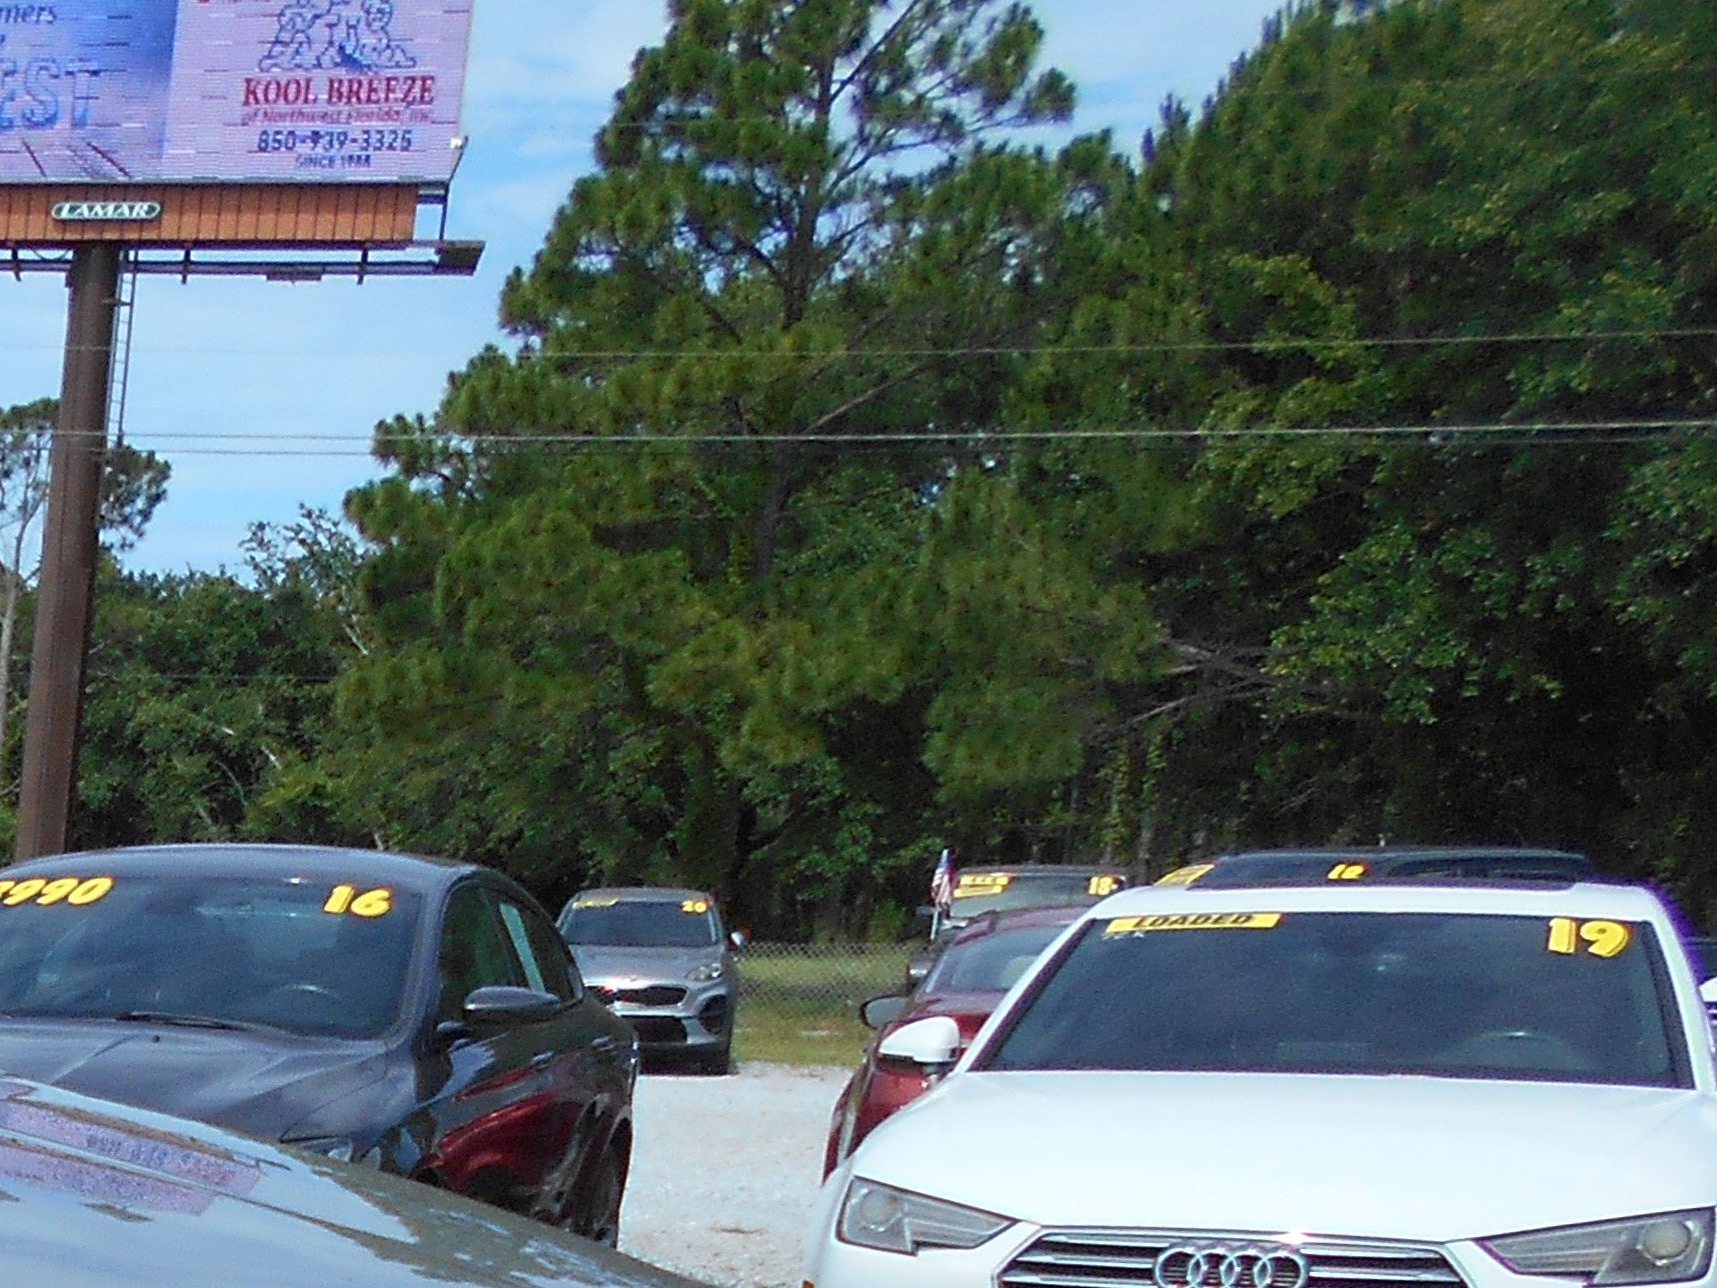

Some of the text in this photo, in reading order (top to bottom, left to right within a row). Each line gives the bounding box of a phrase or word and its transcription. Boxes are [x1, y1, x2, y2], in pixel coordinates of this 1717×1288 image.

[242, 75, 435, 107] KOOL BREEZE
[61, 202, 149, 218] LAMAR
[322, 883, 393, 918] 16
[1132, 913, 1253, 928] LOADED
[1548, 917, 1629, 958] 19
